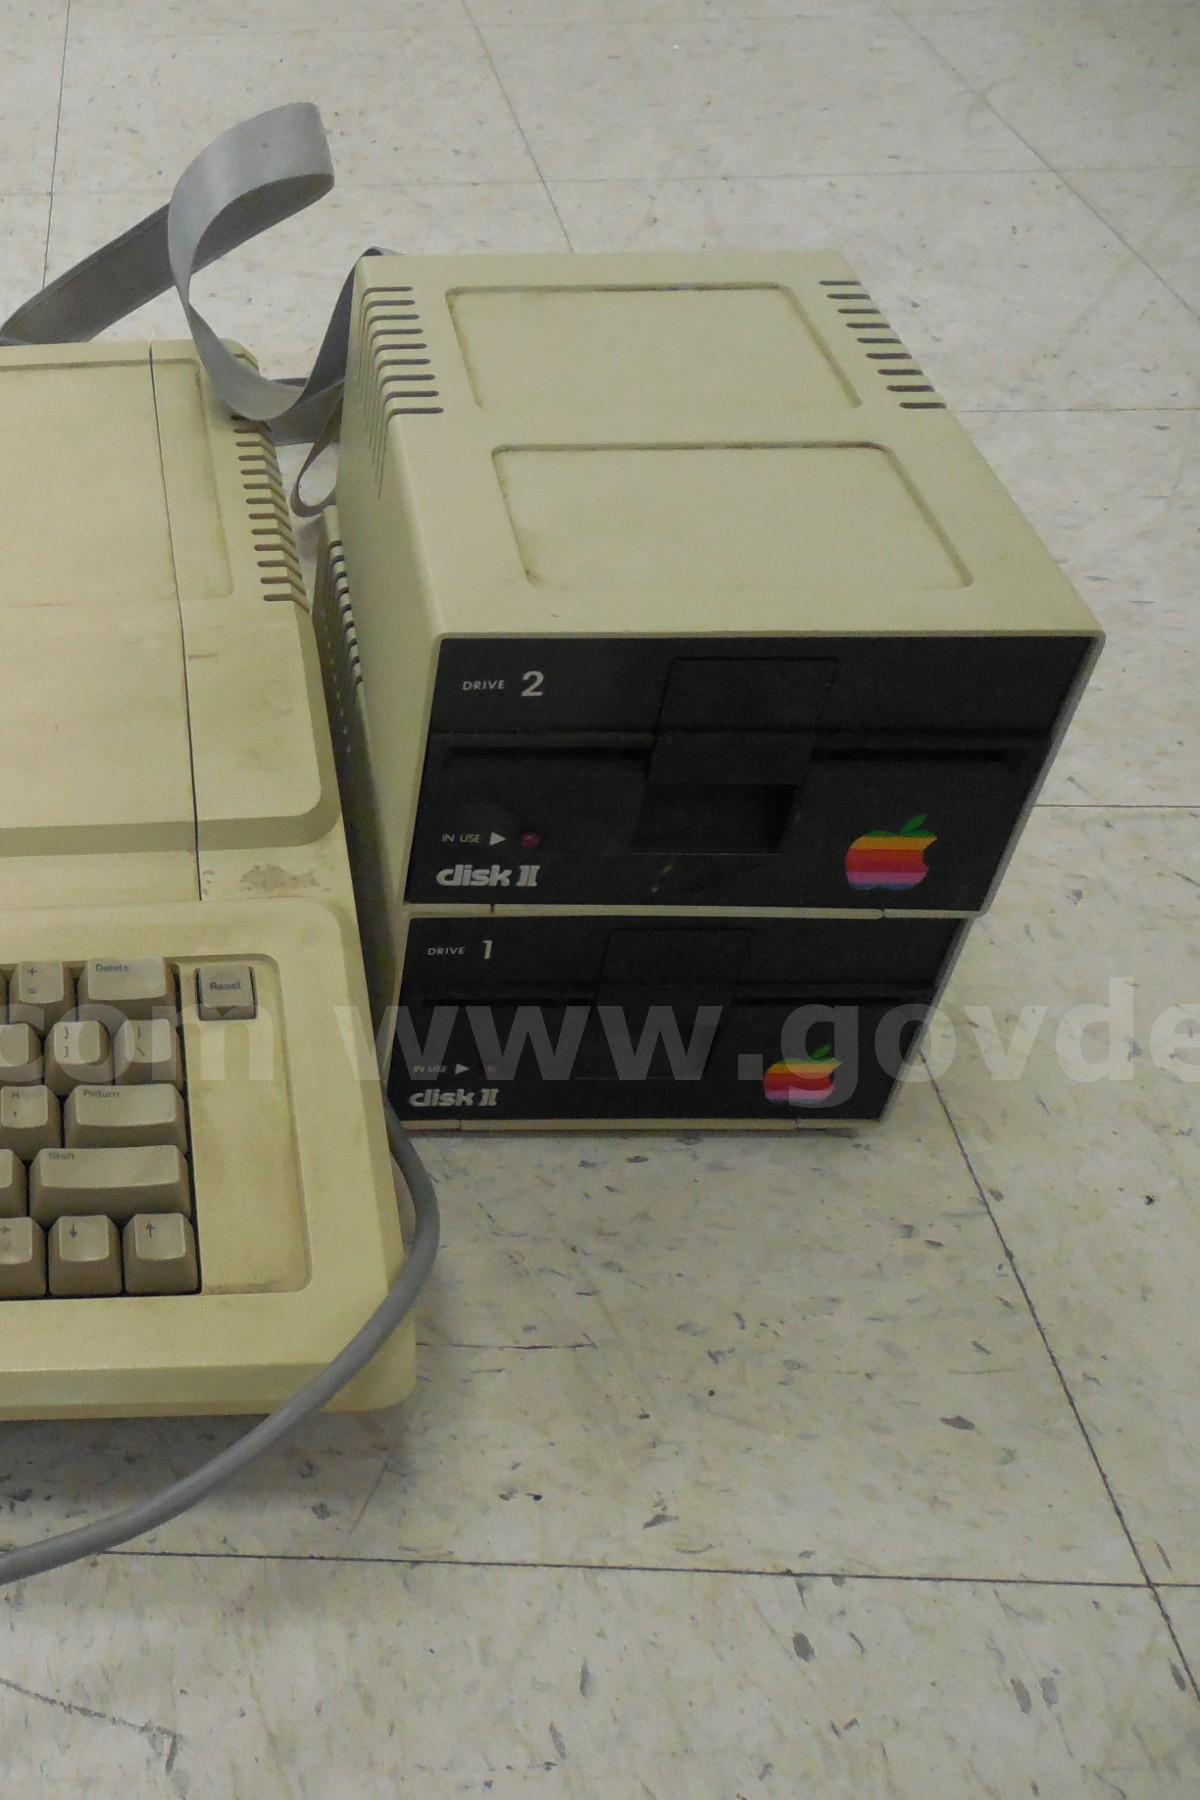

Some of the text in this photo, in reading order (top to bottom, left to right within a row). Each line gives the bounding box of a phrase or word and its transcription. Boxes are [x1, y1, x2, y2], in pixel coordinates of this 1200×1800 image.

[461, 670, 545, 697] DRIVE 2
[441, 833, 481, 843] IN USE
[436, 864, 513, 887] disk
[427, 940, 494, 960] DRIVE 1
[95, 963, 131, 974] Delete
[209, 980, 242, 992] Reset
[408, 1088, 475, 1107] disk
